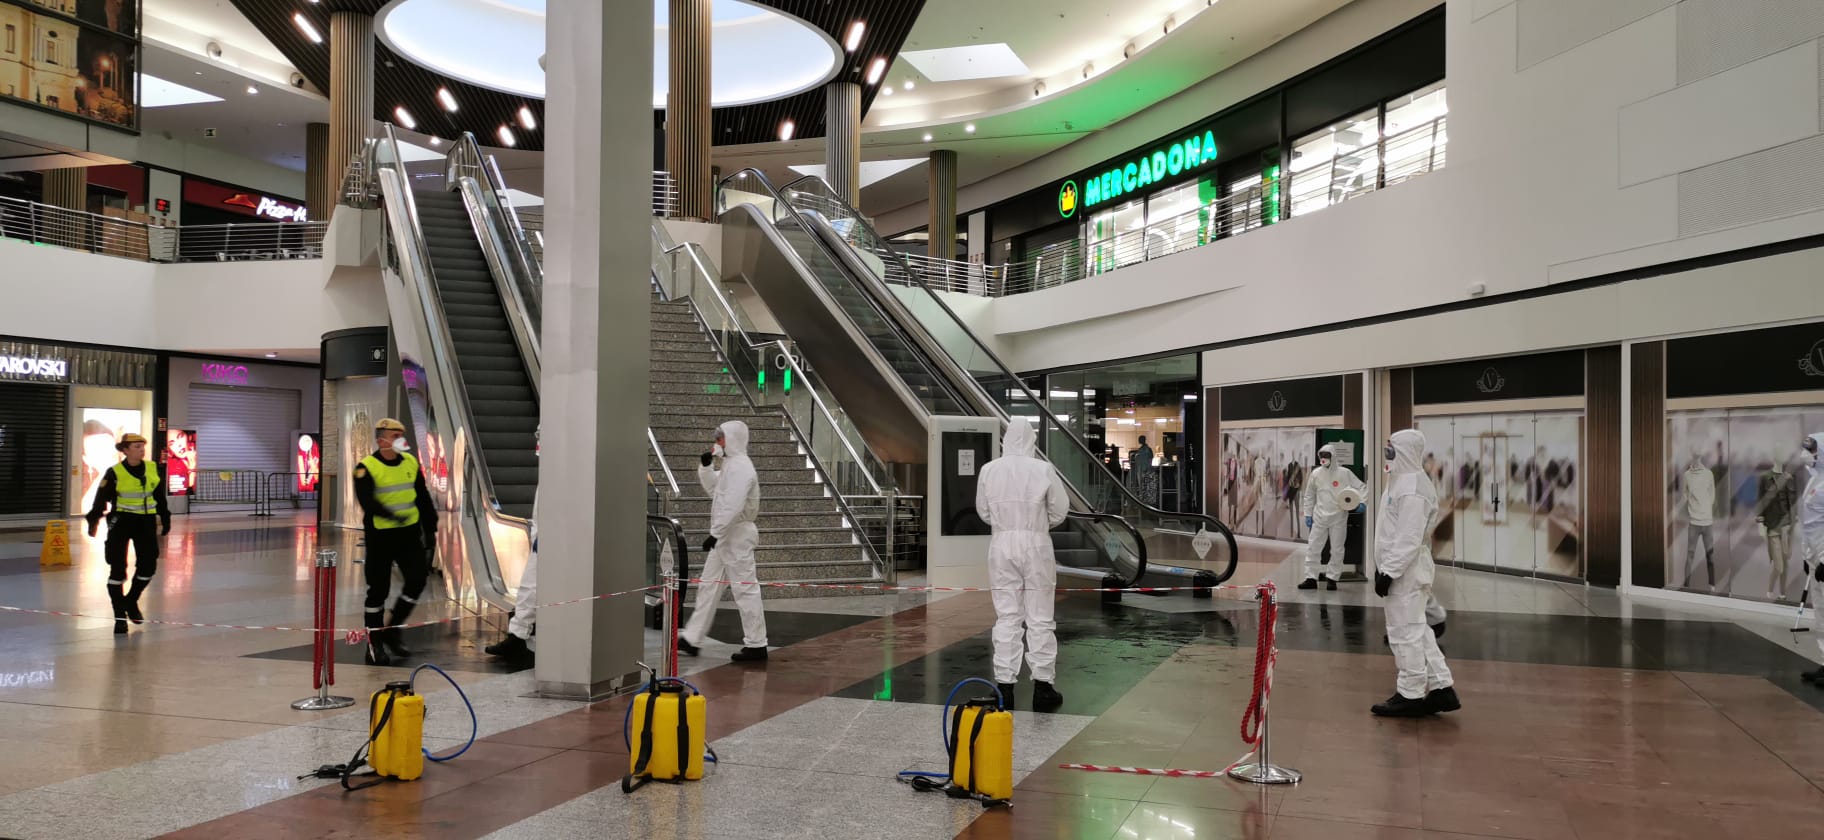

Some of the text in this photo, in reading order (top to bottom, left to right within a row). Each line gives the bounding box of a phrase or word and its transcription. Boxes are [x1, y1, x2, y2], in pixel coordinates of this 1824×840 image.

[1085, 130, 1218, 207] MERCADONA
[256, 196, 294, 219] Pizza
[202, 363, 249, 381] KIKO
